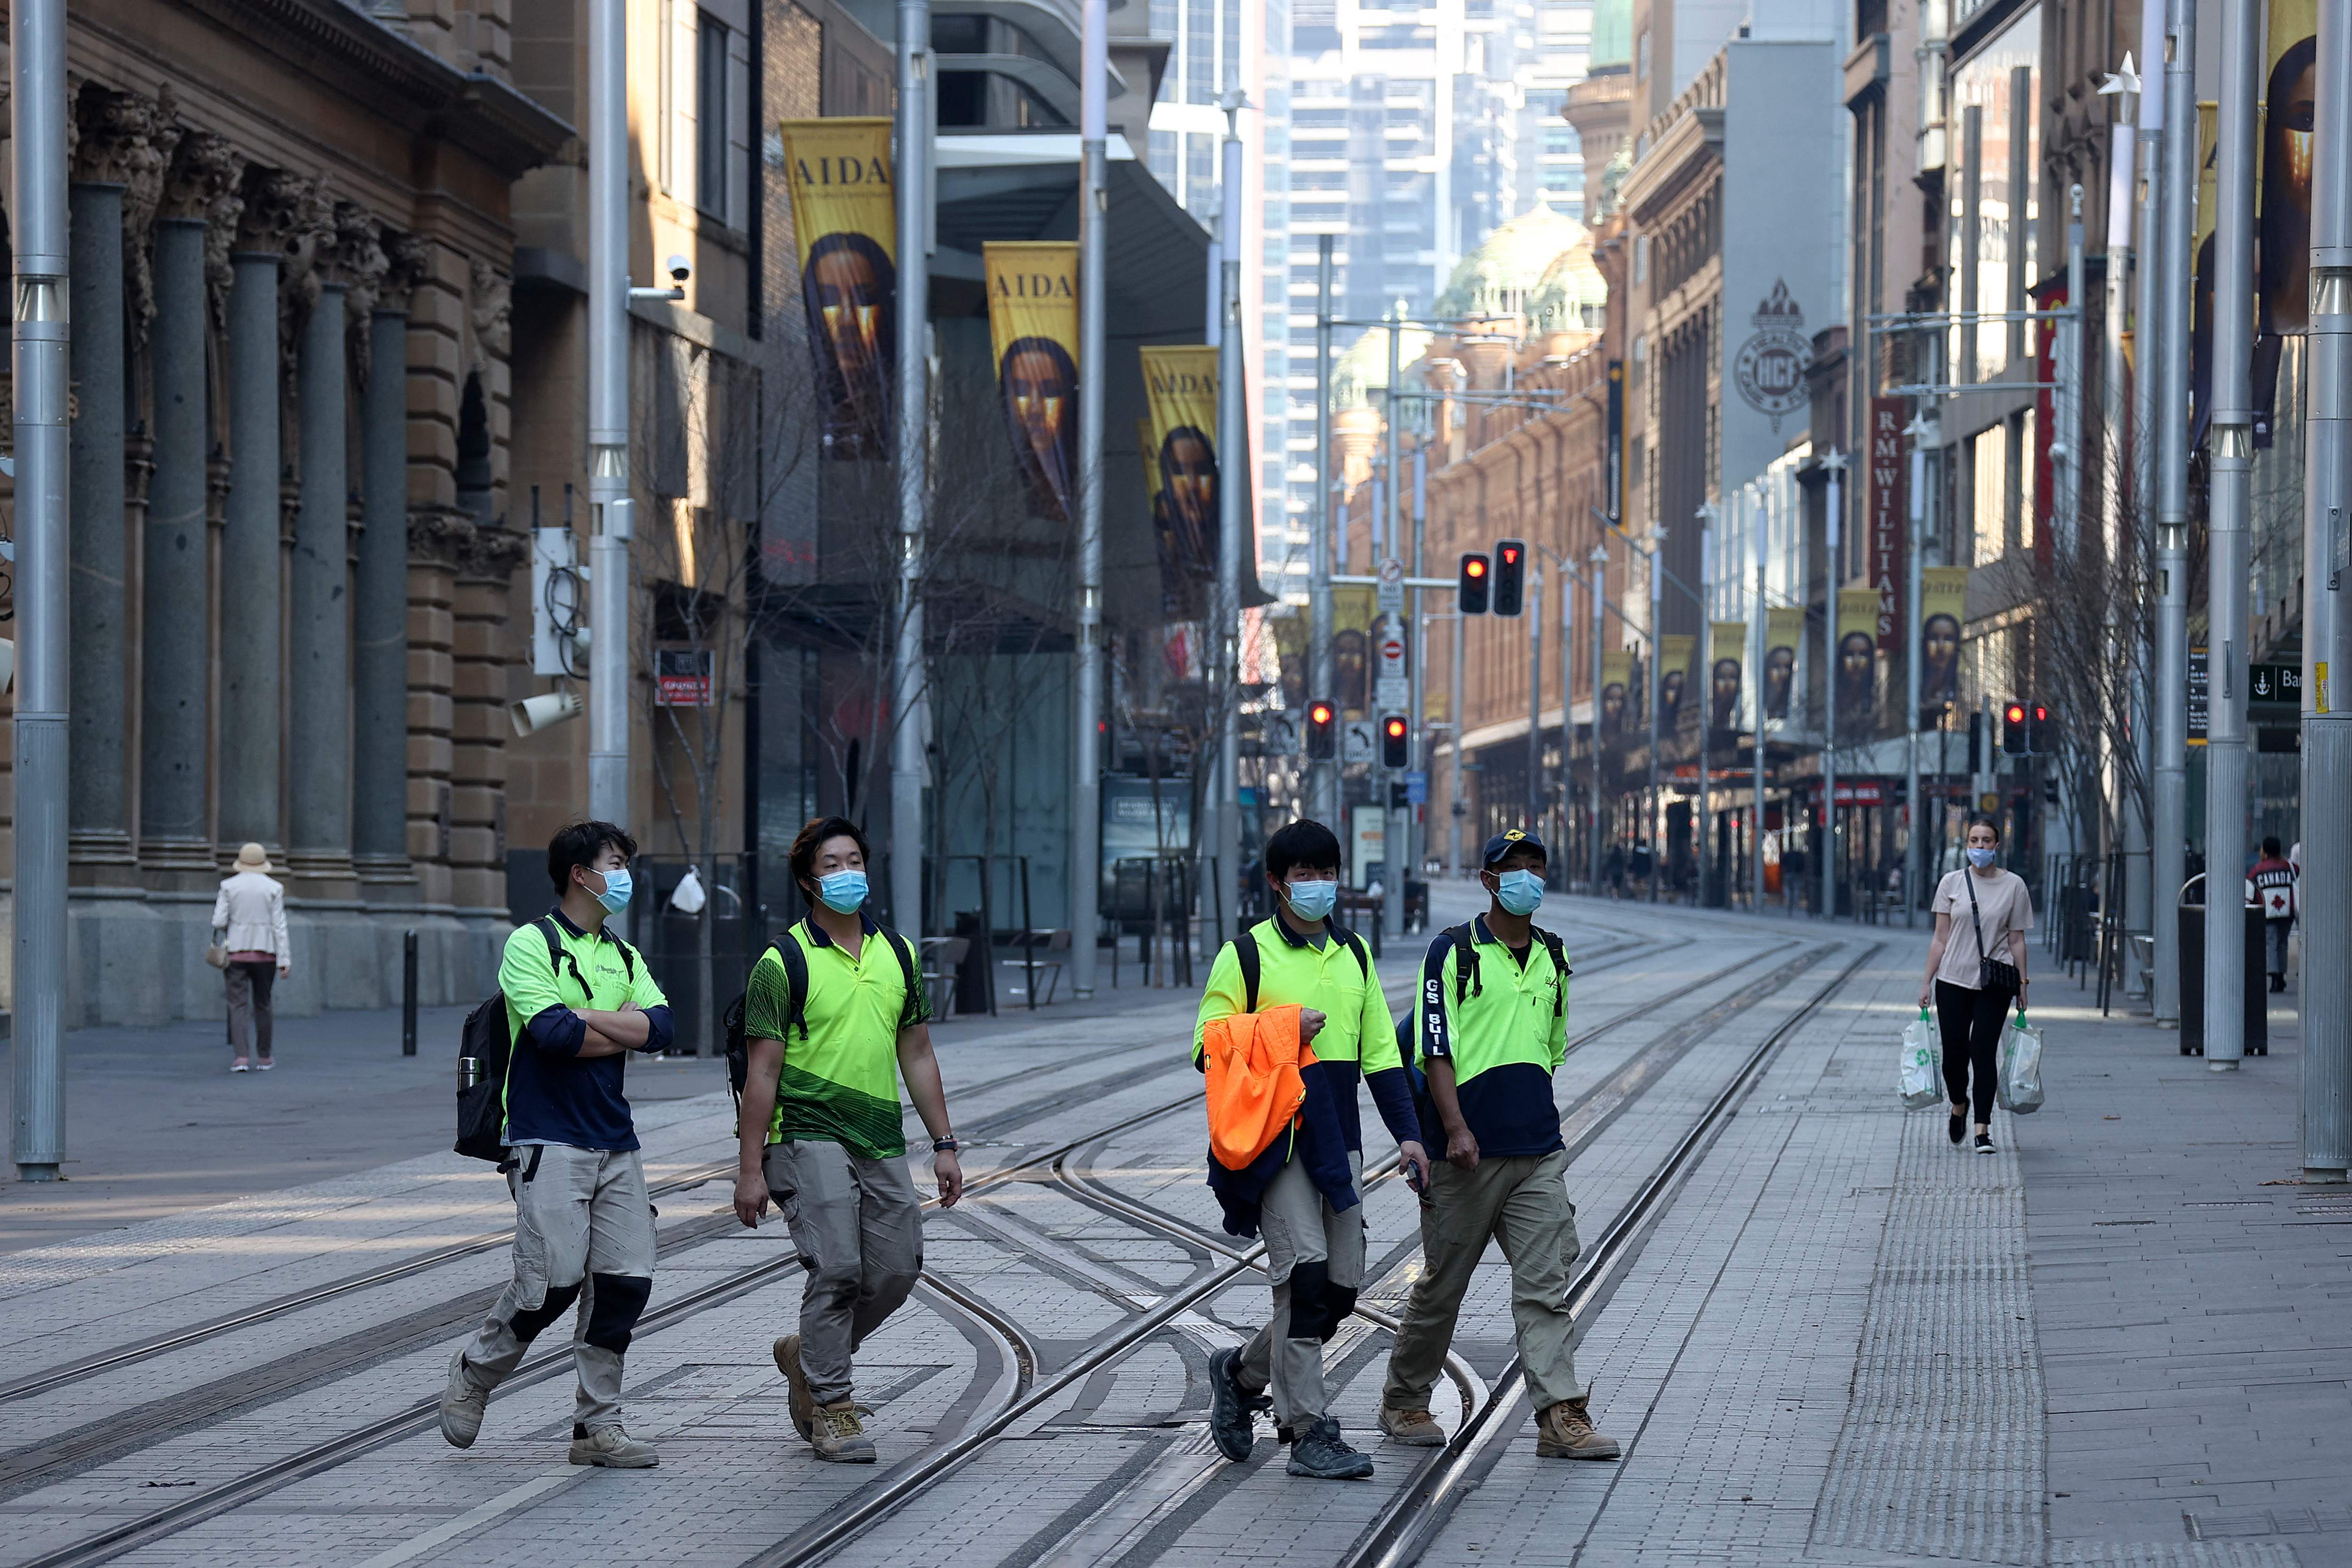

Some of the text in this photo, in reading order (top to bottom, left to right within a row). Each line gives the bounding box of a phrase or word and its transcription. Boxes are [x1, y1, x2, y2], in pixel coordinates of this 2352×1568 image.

[794, 156, 889, 185] AIDA
[993, 272, 1073, 298] AIDA
[1150, 372, 1214, 394] AIDA
[1758, 355, 1797, 388] HCF
[2257, 871, 2291, 887] CANADA
[1426, 979, 1444, 1055] GS BUIL
